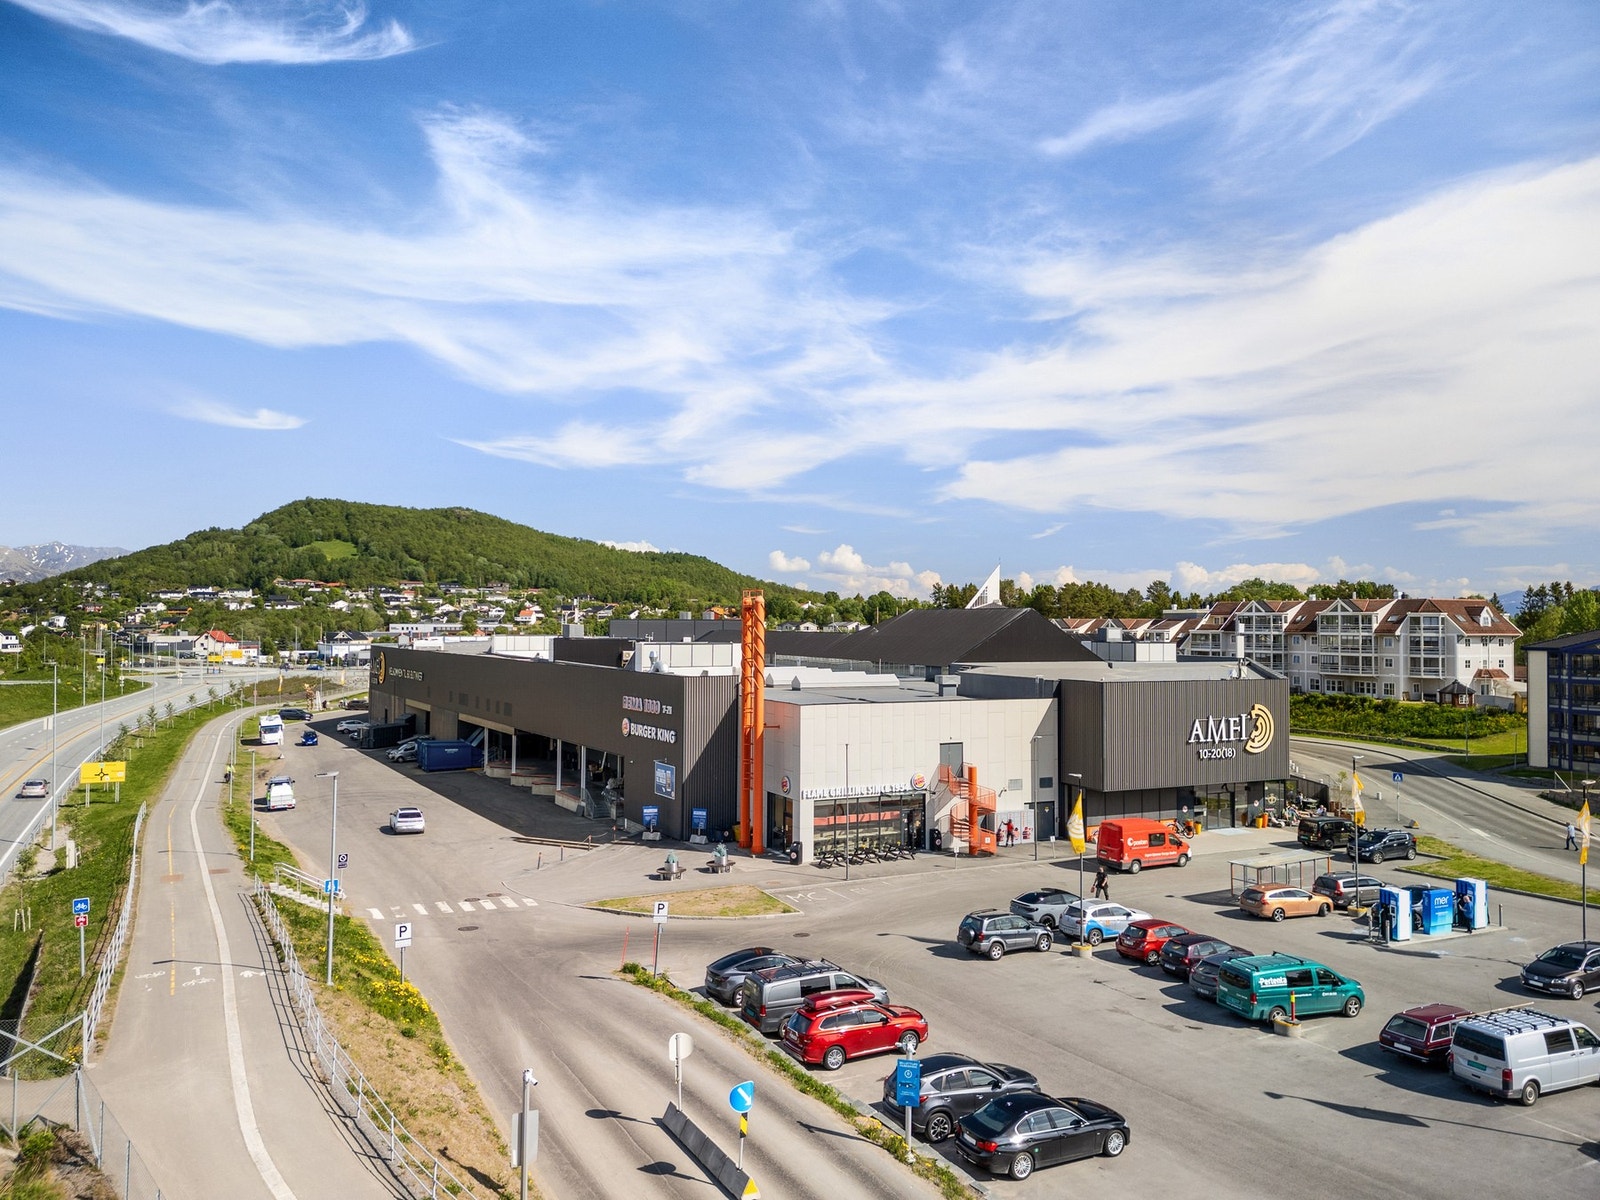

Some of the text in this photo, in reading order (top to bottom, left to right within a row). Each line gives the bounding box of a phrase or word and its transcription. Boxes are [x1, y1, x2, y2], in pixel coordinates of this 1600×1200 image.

[623, 695, 643, 711] REMA
[643, 698, 661, 715] 1000
[630, 722, 676, 744] BURGER KING
[1188, 713, 1249, 744] AMFI
[1199, 747, 1236, 759] 10-20(18)
[802, 788, 828, 800] FLAME
[786, 891, 827, 903] MC
[1434, 896, 1449, 905] mer
[657, 903, 665, 914] P
[399, 925, 408, 938] P
